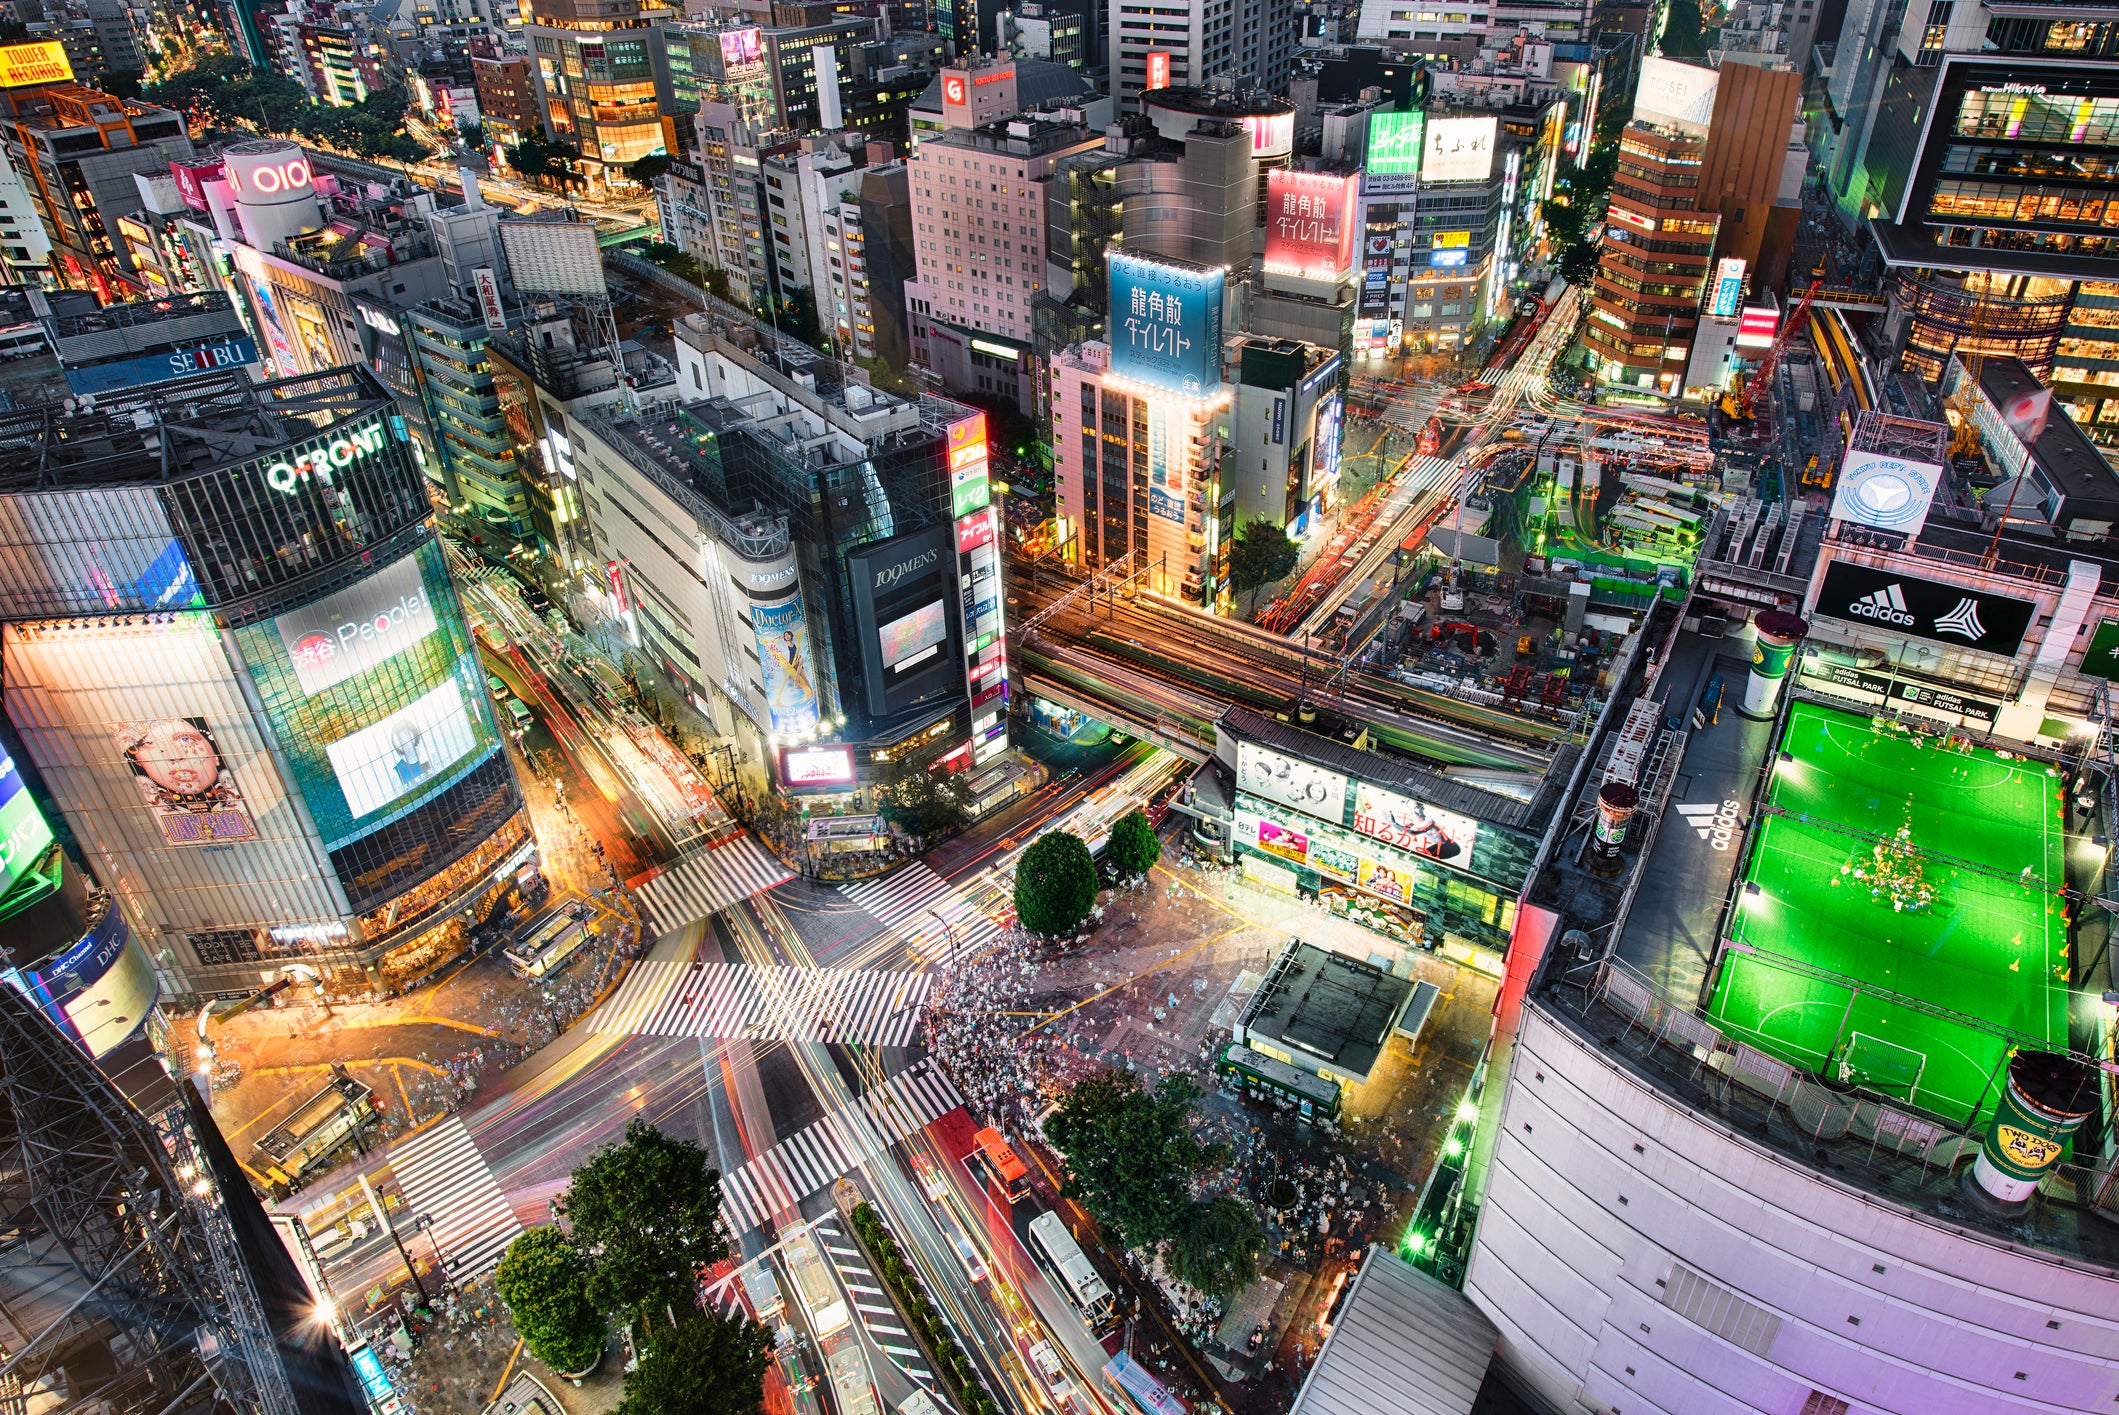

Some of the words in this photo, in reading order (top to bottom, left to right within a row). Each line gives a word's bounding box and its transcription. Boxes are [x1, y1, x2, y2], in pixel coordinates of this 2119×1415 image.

[4, 46, 50, 65] TOWER
[7, 62, 65, 83] RECORDS
[2003, 82, 2047, 95] Hikarie
[1434, 133, 1487, 155] ちふれ
[1283, 192, 1327, 219] 龍角散
[1276, 216, 1333, 244] ダイレクト
[1112, 262, 1202, 291] のど、直接、うるおう
[479, 274, 500, 318] 大和証券
[1131, 286, 1182, 326] 龍角散
[1124, 317, 1191, 358] ダイレクト
[169, 344, 245, 374] SEIBU
[267, 423, 384, 496] QFRONT
[1845, 462, 1876, 481] TOKYU
[1880, 461, 1906, 473] DEPT.
[1908, 470, 1930, 494] STORE
[957, 484, 986, 506] レイク
[960, 521, 990, 541] アイフル
[1849, 601, 1915, 627] adidas
[291, 637, 337, 671] 渋谷
[336, 586, 430, 650] People!
[1832, 675, 1861, 688] FUTSAL
[1862, 681, 1885, 693] PARK.
[1834, 667, 1859, 679] adidas
[1933, 699, 1963, 714] FUTSAL
[1964, 707, 1989, 719] PARK.
[1935, 692, 1962, 705] adidas
[163, 813, 201, 840] LADY
[204, 811, 250, 838] GAGA
[1710, 800, 1741, 851] adidas
[52, 961, 70, 976] DHC
[68, 942, 92, 965] Channel
[97, 933, 121, 967] DHC
[203, 954, 232, 963] CAFE
[2002, 1127, 2029, 1141] TWO
[2031, 1137, 2059, 1153] DOGS
